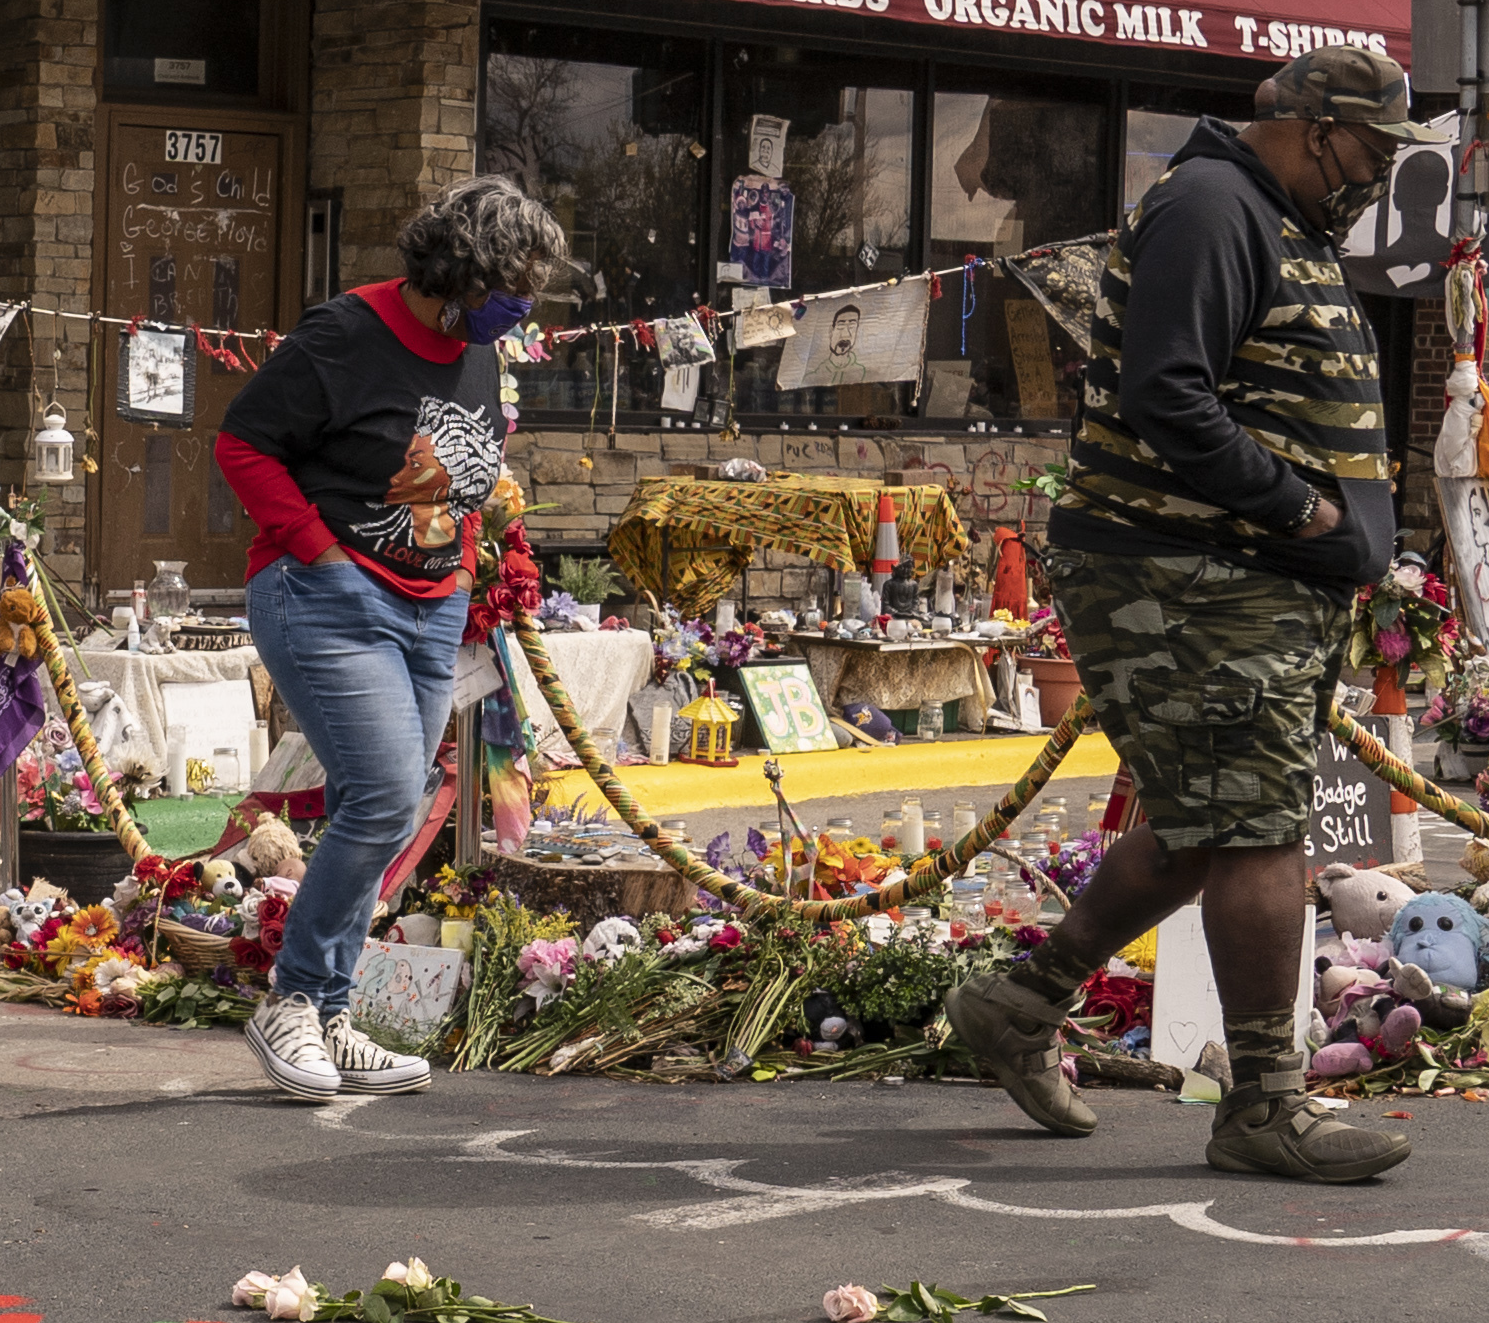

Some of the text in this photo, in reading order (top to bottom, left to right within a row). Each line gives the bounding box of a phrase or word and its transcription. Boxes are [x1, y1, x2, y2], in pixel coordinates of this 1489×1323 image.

[1115, 1, 1209, 49] MILK
[167, 132, 220, 163] 3757
[374, 537, 384, 552] I
[384, 543, 427, 568] LOVE
[756, 677, 825, 738] JB
[1329, 724, 1386, 762] Wh
[1313, 775, 1366, 815] Badge
[1321, 814, 1373, 853] Still
